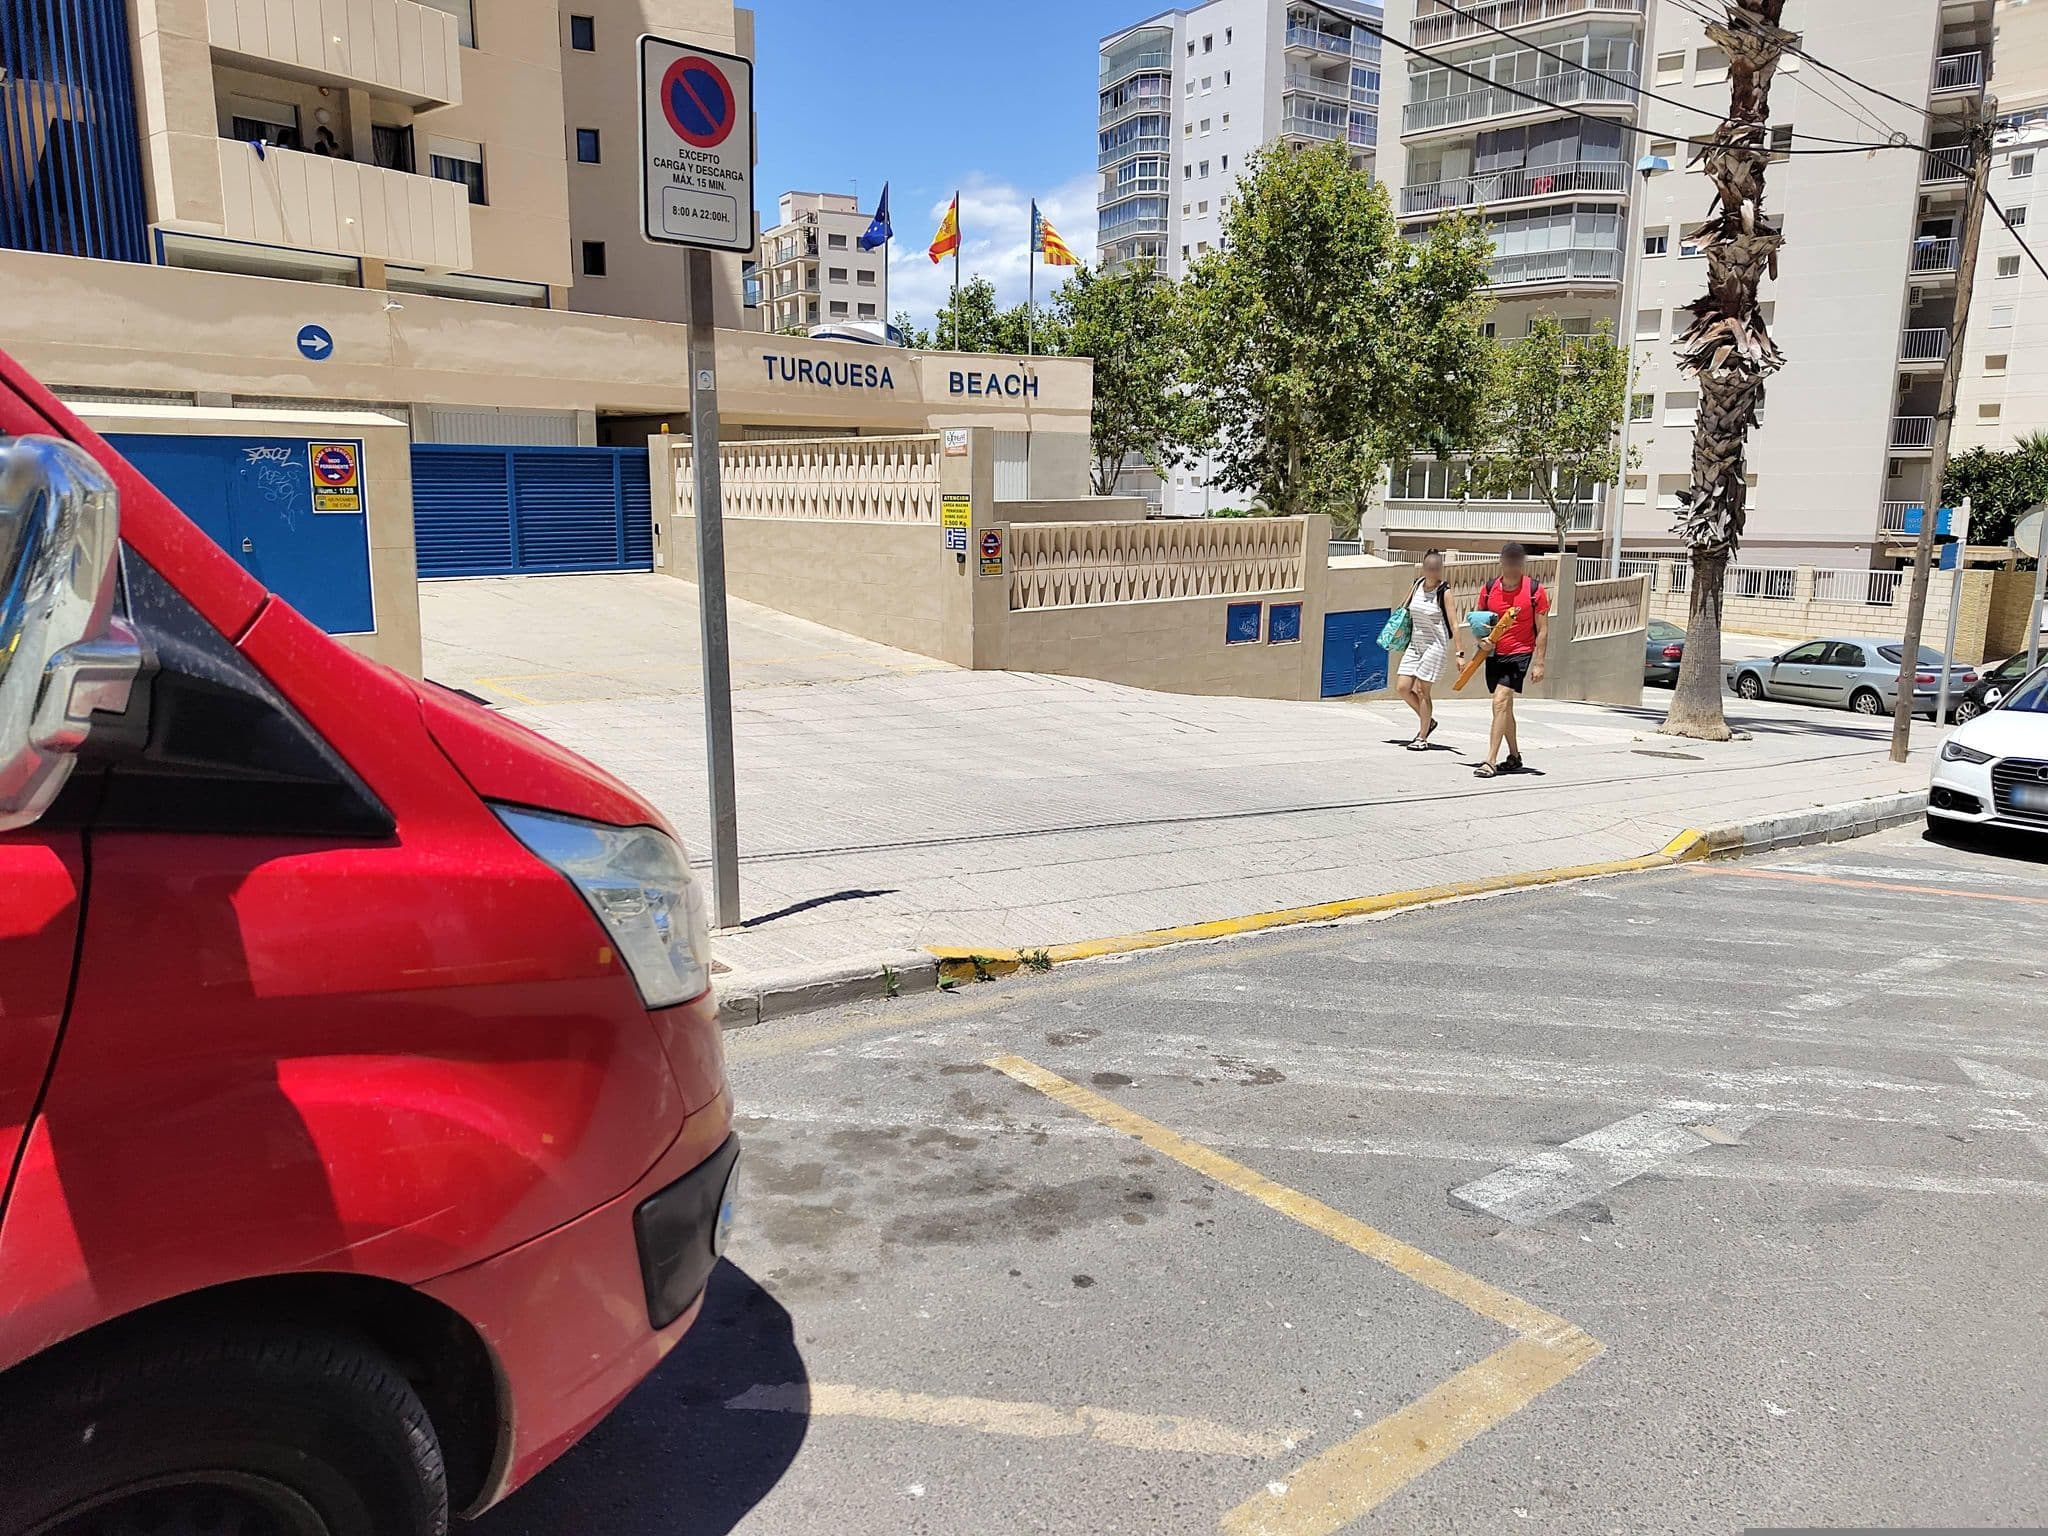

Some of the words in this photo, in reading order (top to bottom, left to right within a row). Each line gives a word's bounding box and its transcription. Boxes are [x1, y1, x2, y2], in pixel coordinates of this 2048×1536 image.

[679, 149, 720, 165] EXCEPTO
[653, 157, 686, 172] CARGA
[688, 163, 694, 173] Y
[696, 164, 744, 181] DESCARGA
[697, 178, 707, 188] 15
[708, 180, 727, 191] MIN.
[672, 205, 690, 217] 8:00
[692, 208, 698, 218] A
[700, 209, 730, 223] 22:00H.
[763, 355, 894, 389] TURQUESA
[949, 370, 1039, 398] BEACH
